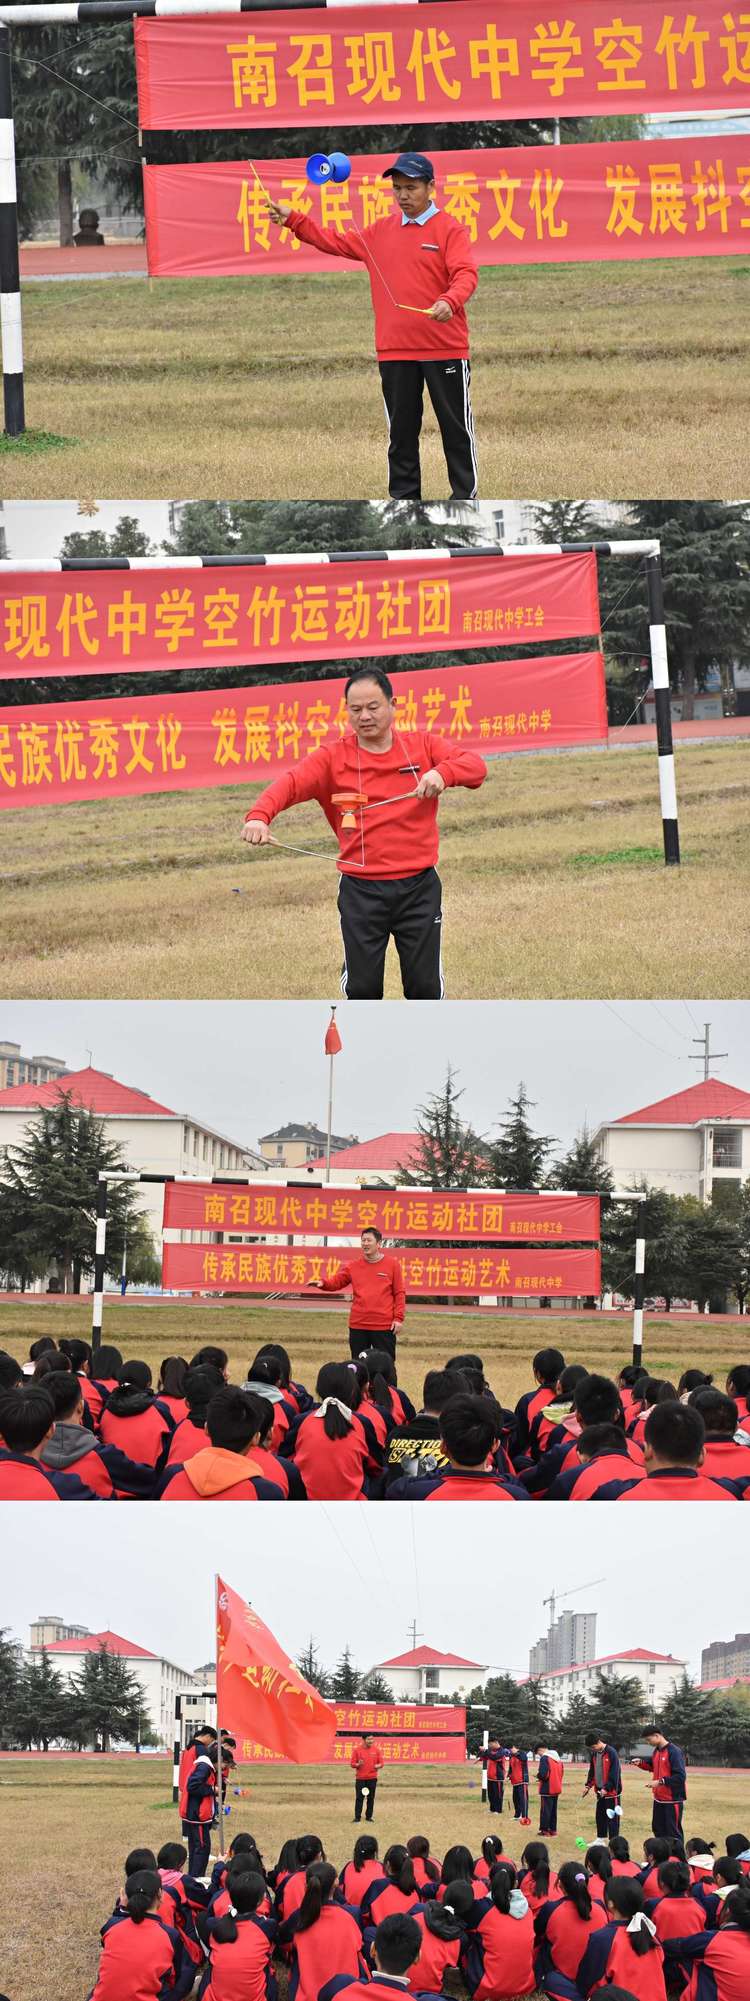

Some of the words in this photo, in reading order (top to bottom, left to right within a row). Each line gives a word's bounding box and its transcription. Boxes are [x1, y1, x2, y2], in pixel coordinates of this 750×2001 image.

[236, 168, 569, 253] 传承民族秀文化
[4, 579, 451, 660] 现代中学空竹运动社团
[463, 605, 544, 632] 南召现代中学工会
[211, 684, 473, 767] 发展抖空动艺术
[480, 708, 552, 738] 南召现代中学
[204, 1193, 504, 1233] 南召现代中学空竹运动社团
[390, 1439, 441, 1448] DIRECTIO
